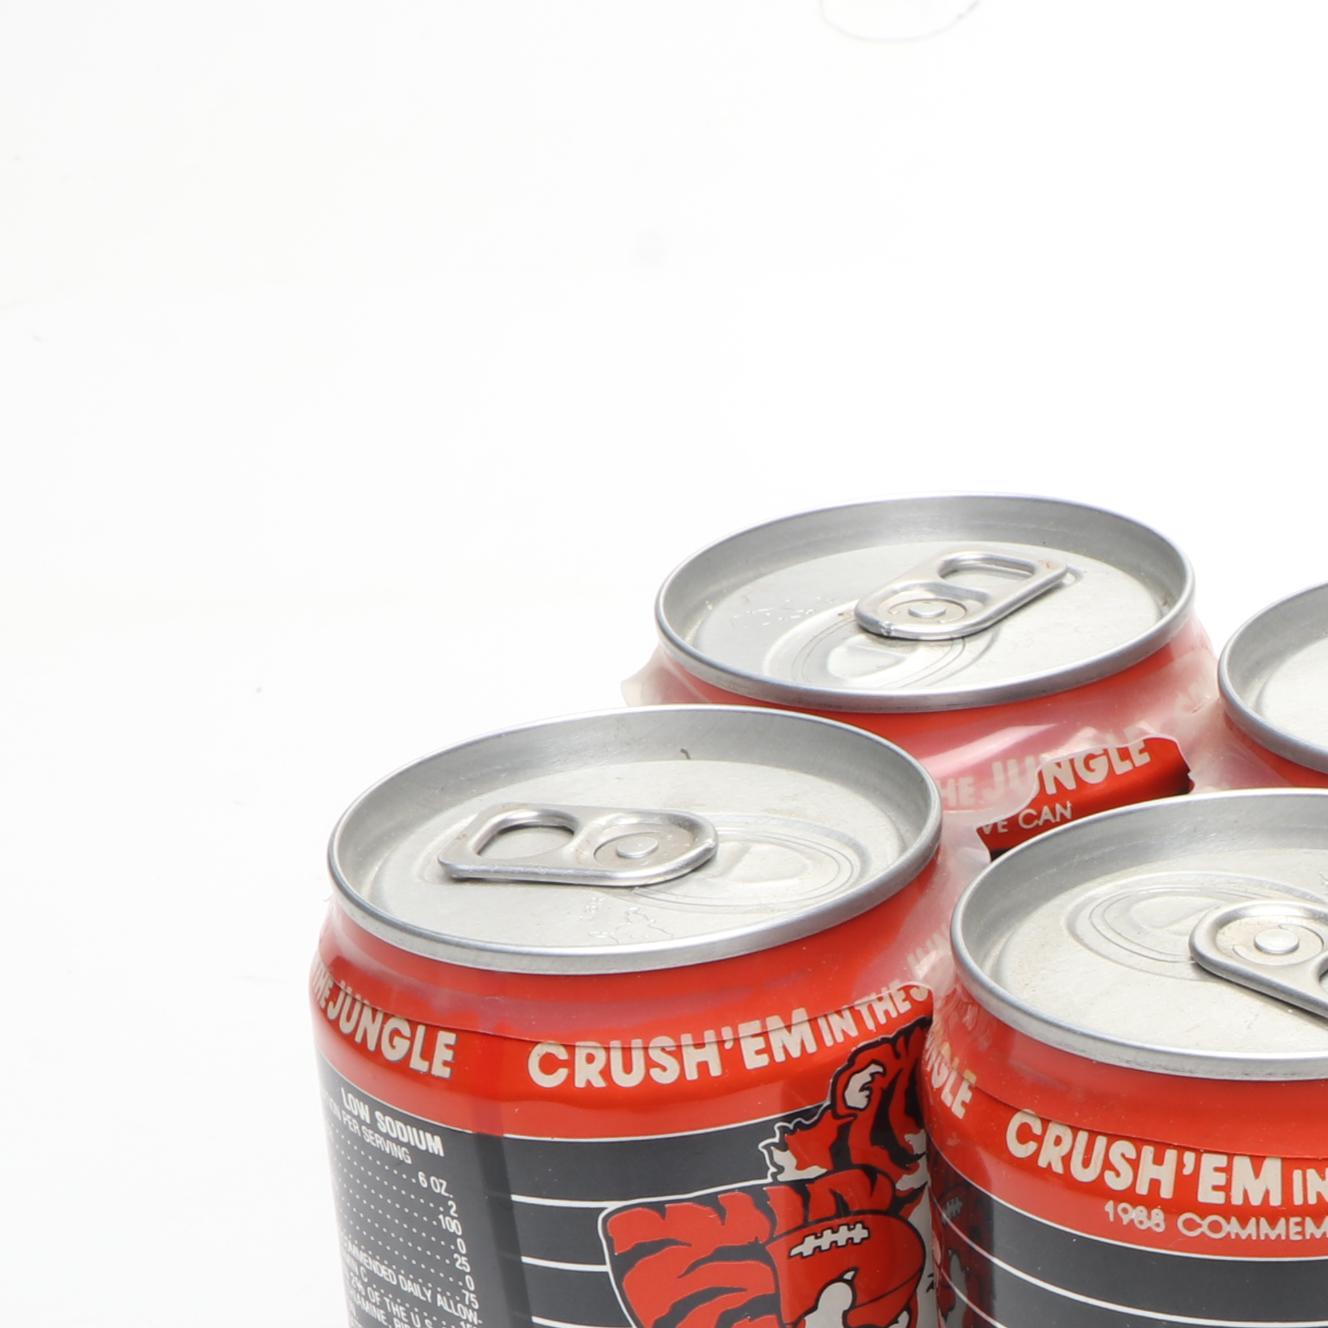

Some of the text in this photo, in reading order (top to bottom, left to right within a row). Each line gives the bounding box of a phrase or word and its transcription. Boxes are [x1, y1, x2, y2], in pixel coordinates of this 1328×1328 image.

[1018, 800, 1073, 831] CAN
[327, 980, 456, 1079] JUNGLE
[818, 1005, 858, 1047] IN
[855, 981, 912, 1031] THE
[341, 1087, 371, 1125] LOW
[374, 1110, 444, 1157] SODIUM
[361, 1127, 412, 1164] SERVING
[418, 1171, 428, 1188] 6
[1104, 1199, 1167, 1234] 1988
